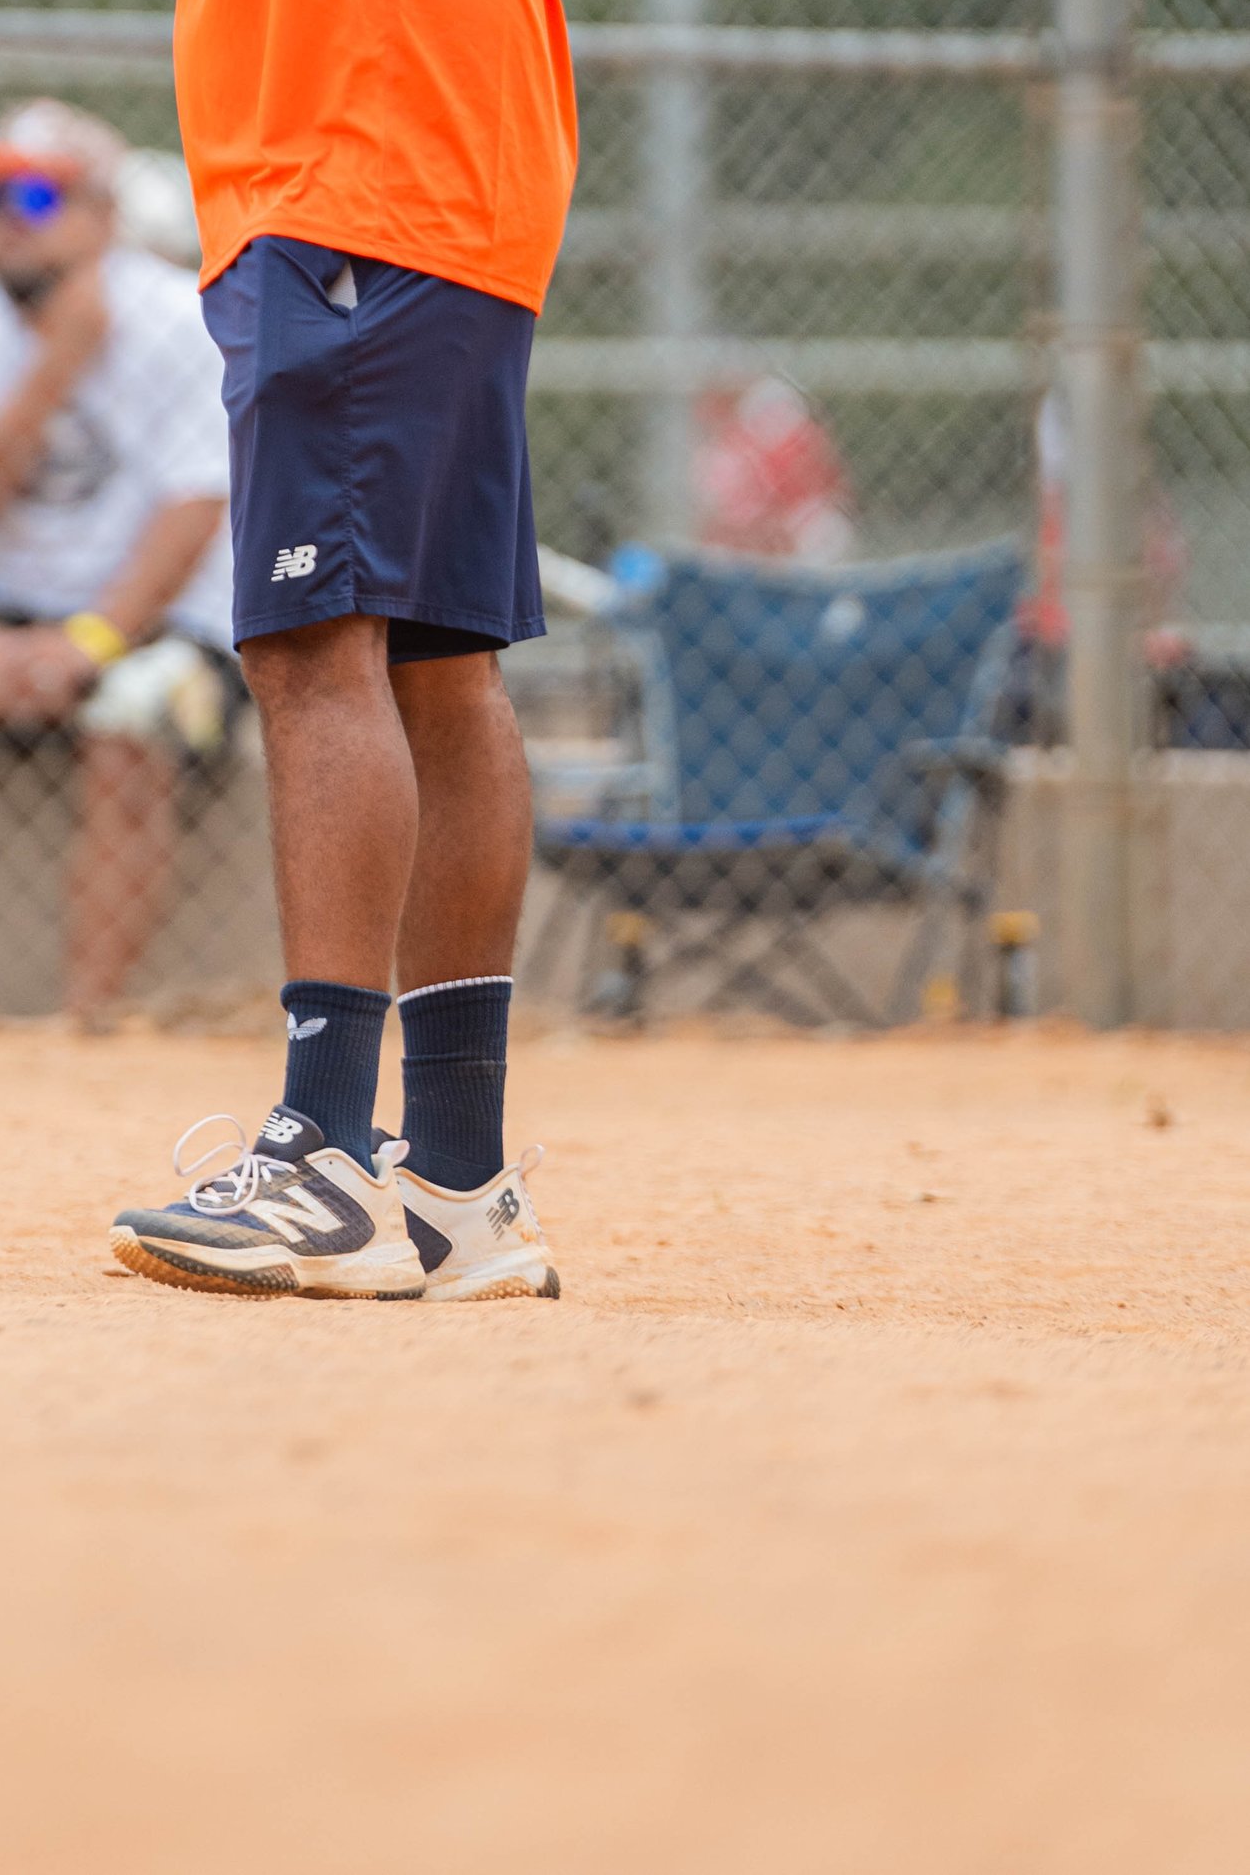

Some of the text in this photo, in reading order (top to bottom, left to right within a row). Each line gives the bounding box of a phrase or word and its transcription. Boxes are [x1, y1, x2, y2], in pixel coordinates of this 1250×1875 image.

[270, 544, 318, 582] NB
[244, 1184, 344, 1243] N
[486, 1187, 520, 1241] NB
